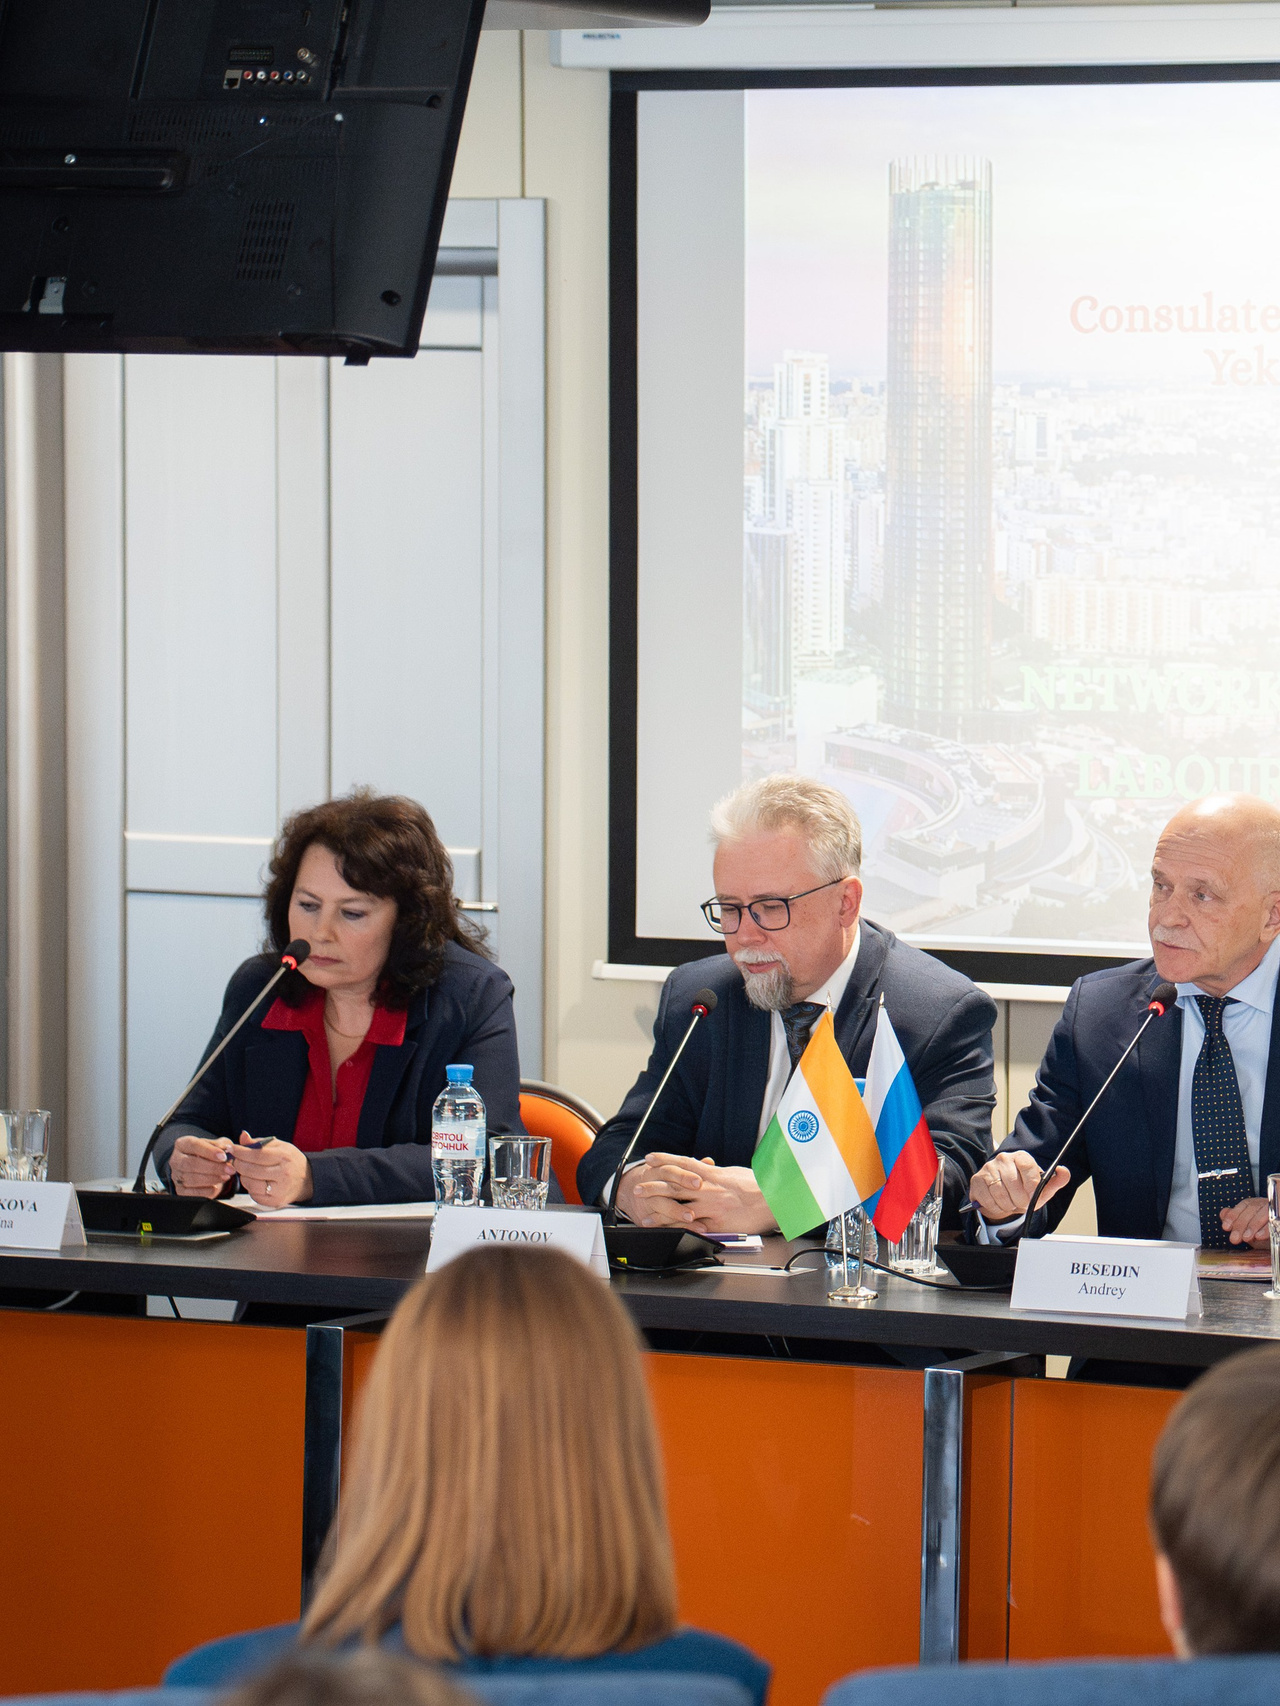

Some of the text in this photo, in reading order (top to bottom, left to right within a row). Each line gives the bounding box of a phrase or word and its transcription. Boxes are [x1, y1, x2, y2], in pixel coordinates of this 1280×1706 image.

[477, 1229, 553, 1243] ANTONOV
[1070, 1262, 1140, 1278] BESEDIN
[1078, 1282, 1127, 1300] Andrey
